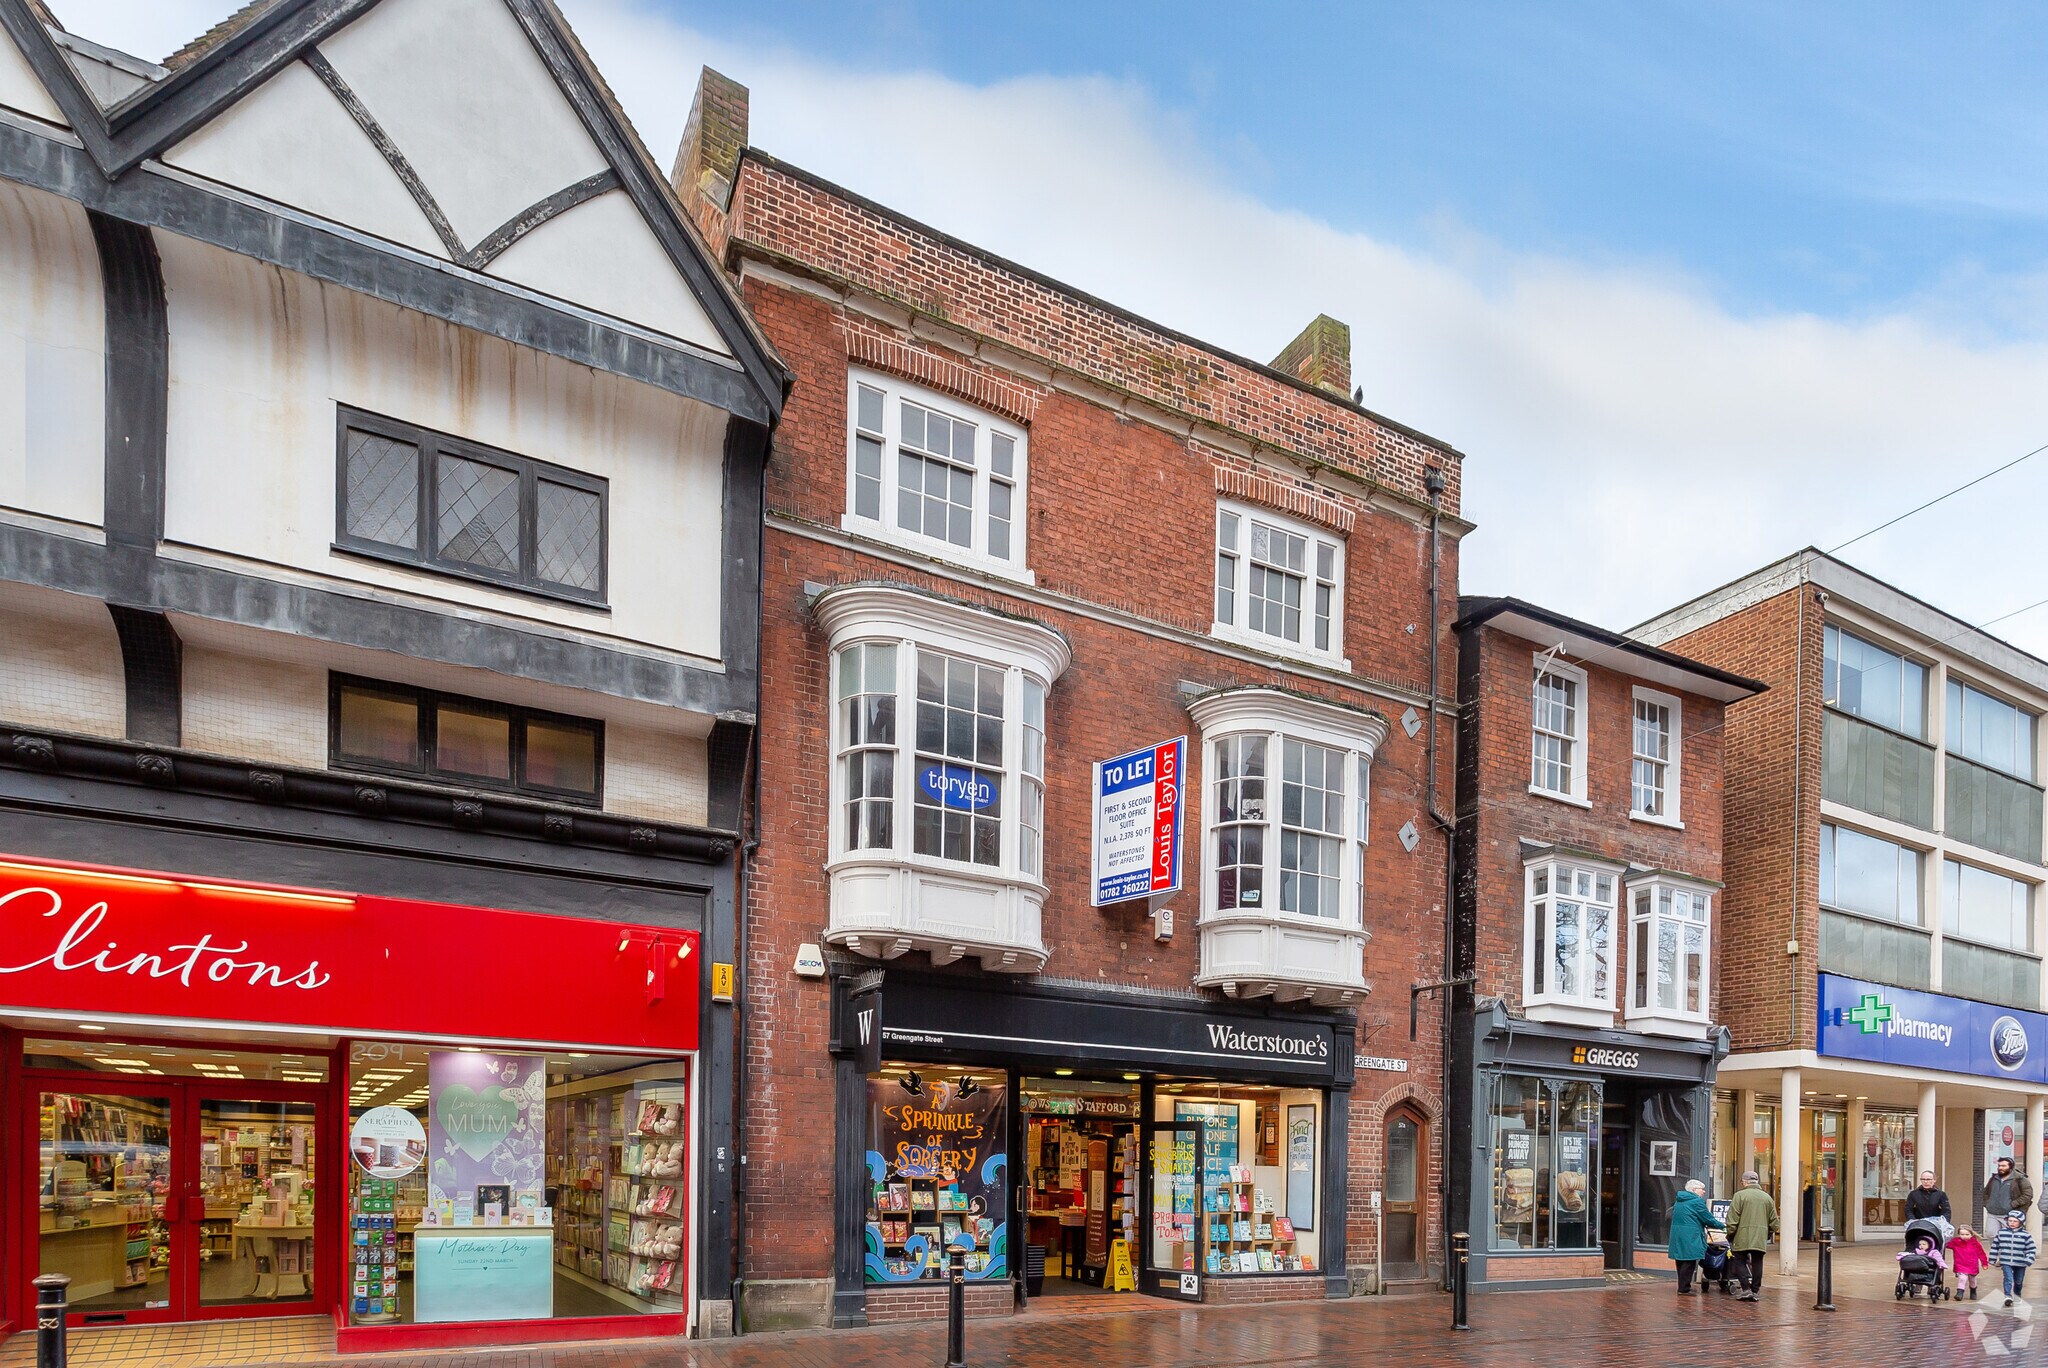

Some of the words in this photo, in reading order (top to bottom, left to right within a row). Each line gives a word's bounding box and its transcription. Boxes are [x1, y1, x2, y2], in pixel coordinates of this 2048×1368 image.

[1105, 767, 1123, 787] TO
[1128, 757, 1152, 781] LET
[928, 770, 989, 799] toryen
[1156, 751, 1179, 820] Taylor
[1104, 804, 1120, 815] FIRST
[1121, 802, 1126, 810] &
[1128, 795, 1153, 809] SECOND
[1109, 812, 1127, 823] FLOOR
[1128, 807, 1147, 819] OFFICE
[1120, 819, 1135, 830] SUITE
[1104, 835, 1118, 844] N.I.A.
[1119, 831, 1134, 841] 2,378
[1135, 828, 1143, 837] SQ
[1144, 826, 1151, 835] FT
[1108, 846, 1145, 860] WATERSTONES
[1108, 859, 1119, 867] NOT
[1119, 853, 1145, 865] AFFECTED
[1154, 823, 1172, 884] Louis
[1100, 886, 1120, 899] 01782
[1122, 880, 1149, 895] 260222
[0, 887, 330, 989] Clintons
[798, 960, 822, 968] SECOM
[858, 1009, 874, 1046] W
[1887, 1011, 1953, 1047] pharmacy
[891, 1033, 924, 1043] Greengate
[924, 1035, 943, 1044] Street
[1206, 1024, 1328, 1057] Waterstone's
[1354, 1057, 1395, 1069] GREENGATE
[1397, 1061, 1406, 1070] ST
[1586, 1048, 1640, 1069] GREGGS
[451, 1096, 478, 1111] Love
[930, 1092, 941, 1110] A
[364, 1118, 415, 1126] SERAPHINE
[448, 1113, 507, 1133] MUM
[901, 1105, 974, 1132] SPRINKLE
[1206, 1117, 1228, 1128] ONE
[927, 1134, 943, 1147] OF
[1207, 1131, 1227, 1141] ONE
[1508, 1140, 1530, 1149] HUNGER
[1563, 1136, 1573, 1145] IT'S
[1573, 1137, 1582, 1146] THE
[894, 1141, 978, 1173] SORCERY
[1203, 1144, 1221, 1155] ALF
[1507, 1148, 1529, 1160] AWAY
[438, 1238, 497, 1257] Mother's
[500, 1238, 531, 1256] Day
